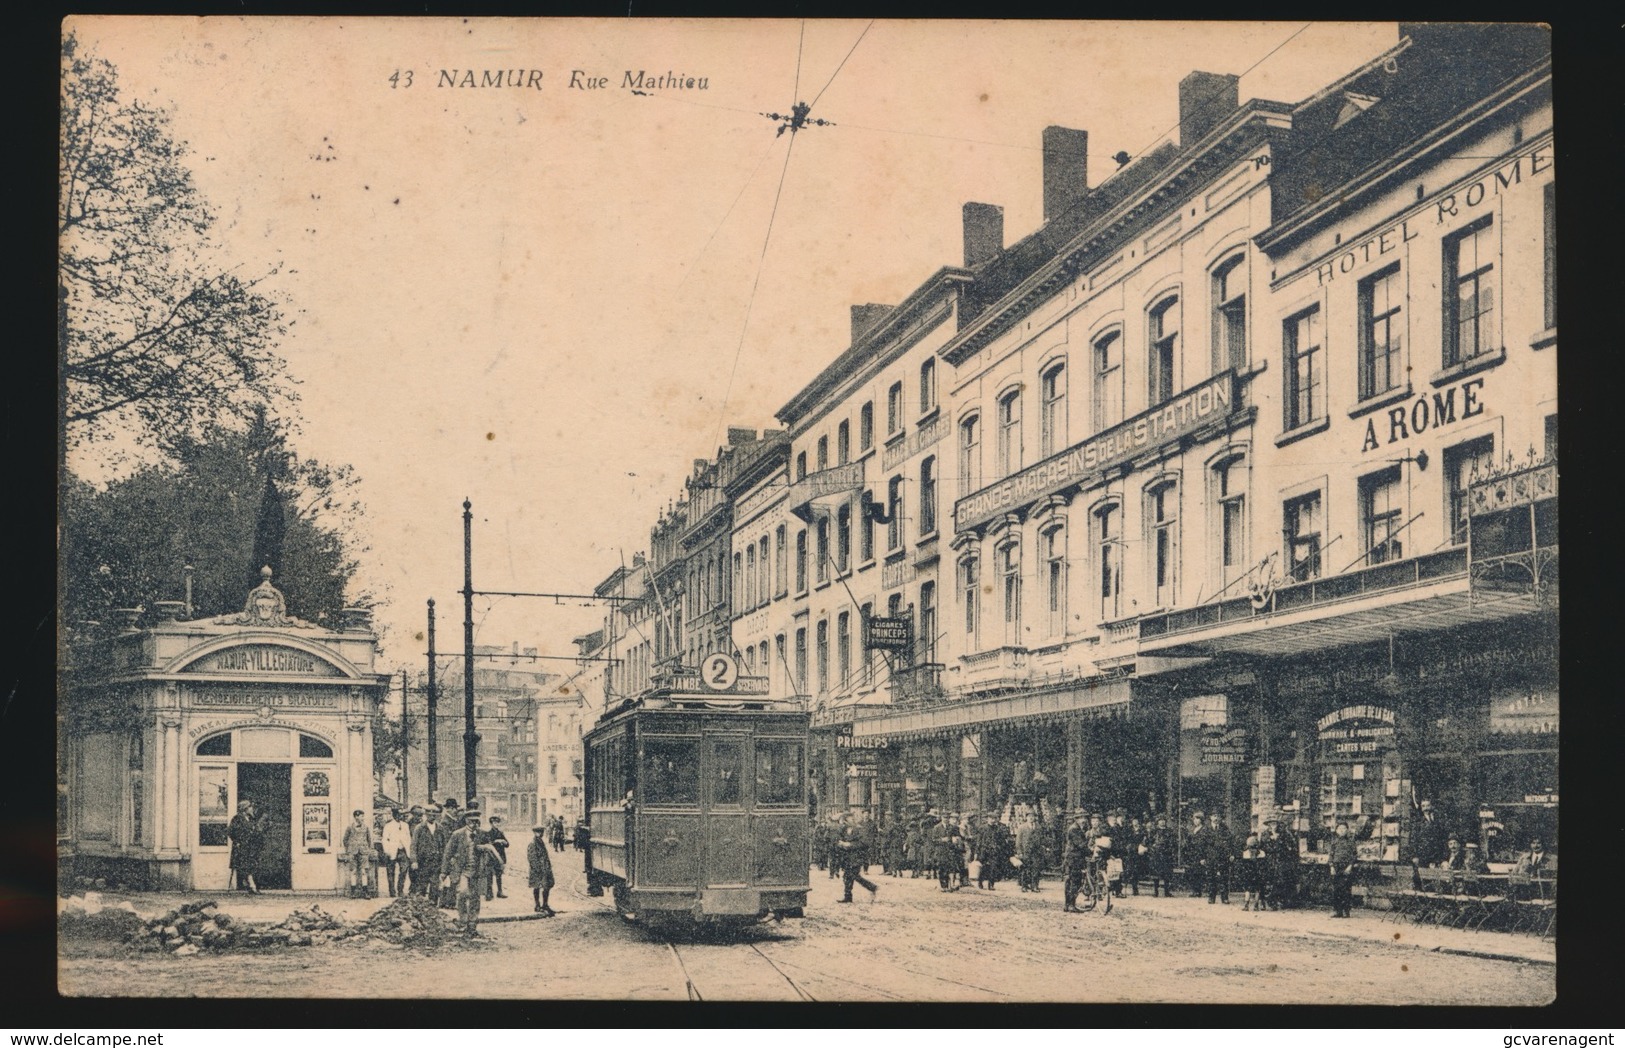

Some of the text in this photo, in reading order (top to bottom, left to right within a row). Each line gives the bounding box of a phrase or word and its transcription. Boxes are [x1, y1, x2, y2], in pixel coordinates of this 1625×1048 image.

[1317, 142, 1553, 288] HOTEL ROME
[957, 379, 1231, 524] GRANDS MAGASINS DE LA STATION
[874, 621, 903, 629] CIGARES
[871, 629, 907, 639] PRINCEPS
[712, 658, 728, 684] 2
[189, 718, 229, 739] BUREAU
[837, 735, 889, 749] PRINCEPS
[1336, 743, 1359, 753] CARTES
[1202, 754, 1245, 763] JOURNAUX
